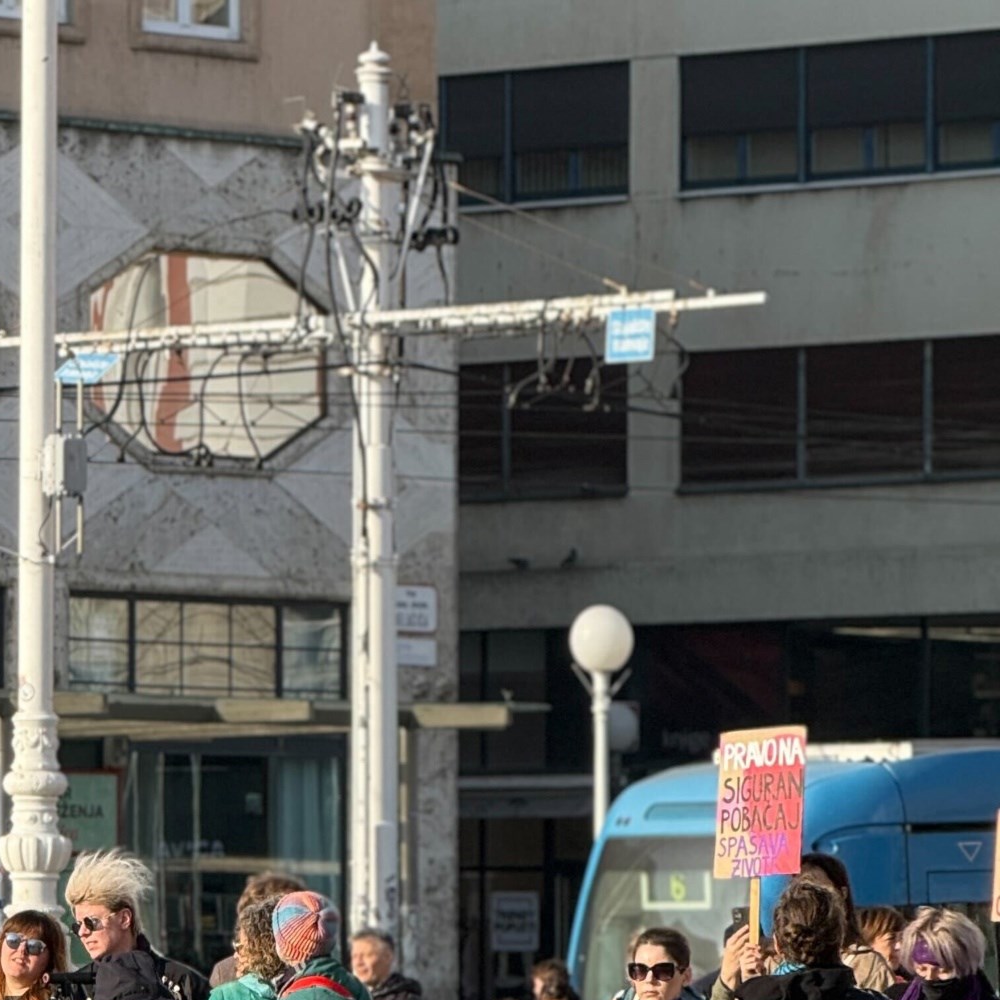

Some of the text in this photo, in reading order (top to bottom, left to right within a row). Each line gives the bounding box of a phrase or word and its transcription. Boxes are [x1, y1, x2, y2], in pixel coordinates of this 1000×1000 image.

[723, 736, 805, 771] PRAVO NA
[722, 768, 804, 804] SIGURAN
